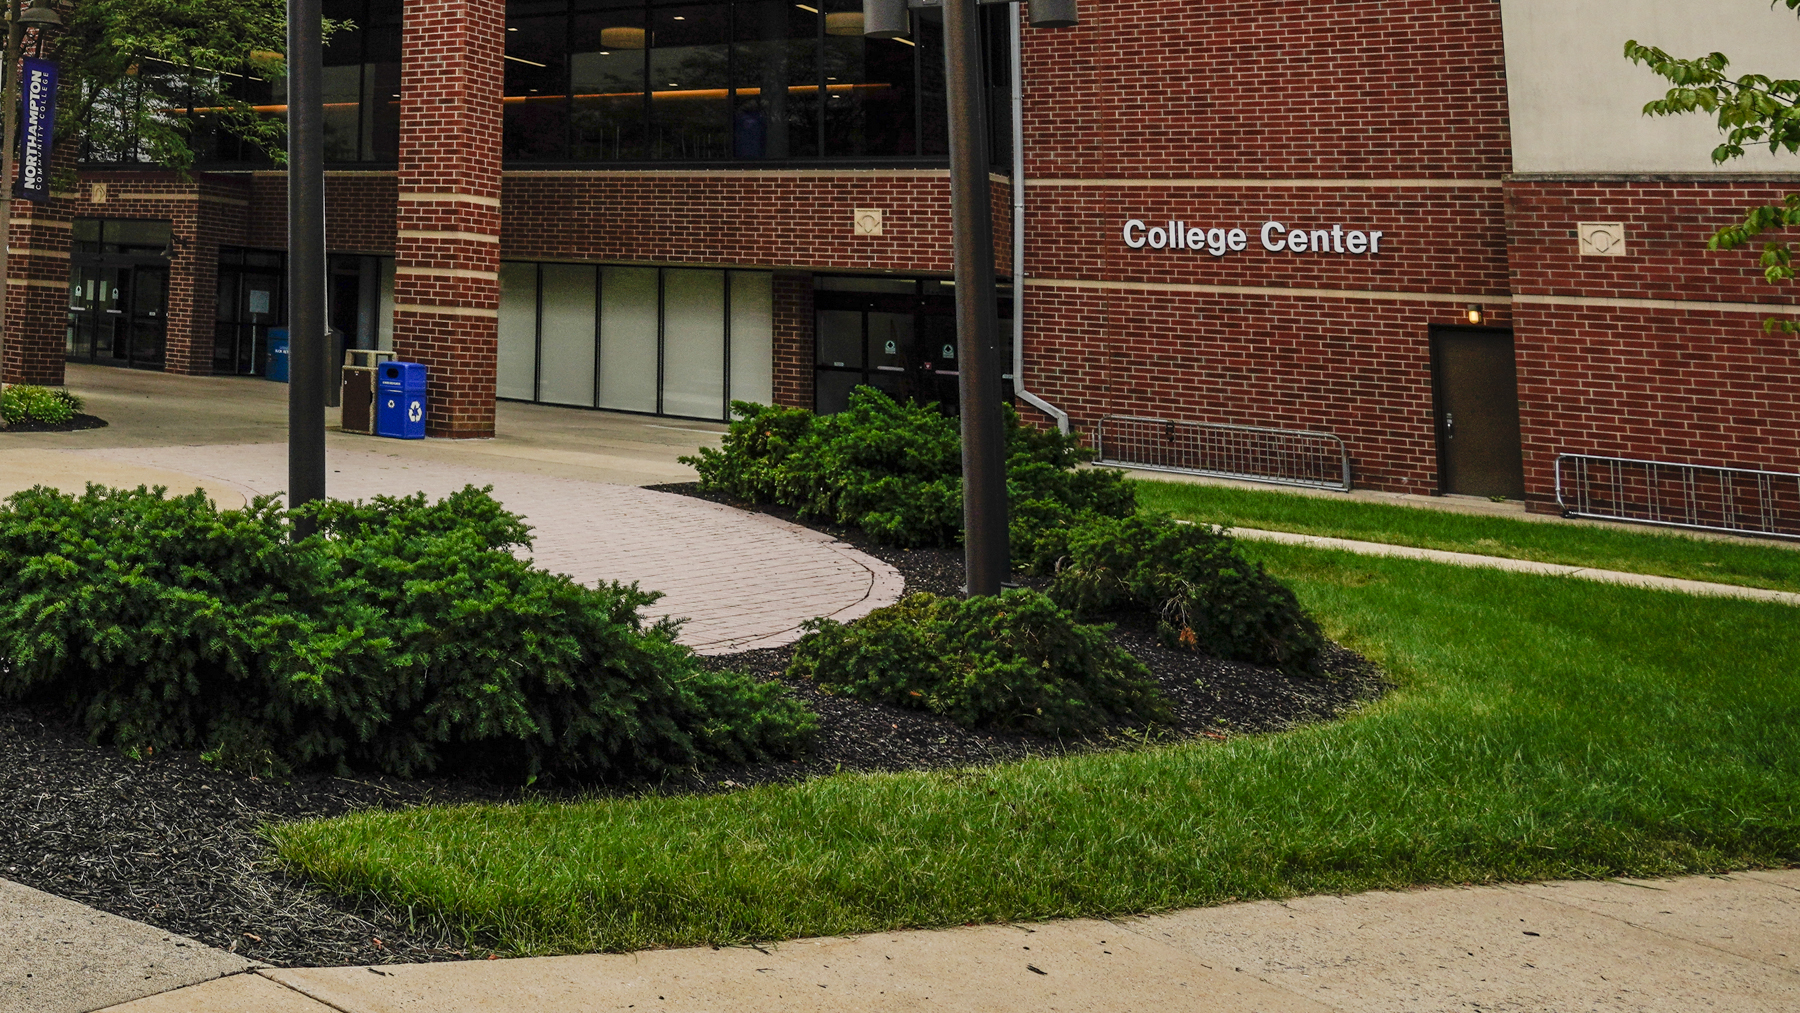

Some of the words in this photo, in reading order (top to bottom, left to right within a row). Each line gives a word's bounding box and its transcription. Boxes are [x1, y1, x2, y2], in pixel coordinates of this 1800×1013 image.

[39, 72, 49, 119] COLLEGE
[24, 70, 42, 189] NORTHAMPTON
[35, 126, 44, 190] COMMUNITY
[1122, 219, 1247, 256] College
[1260, 220, 1383, 255] Center
